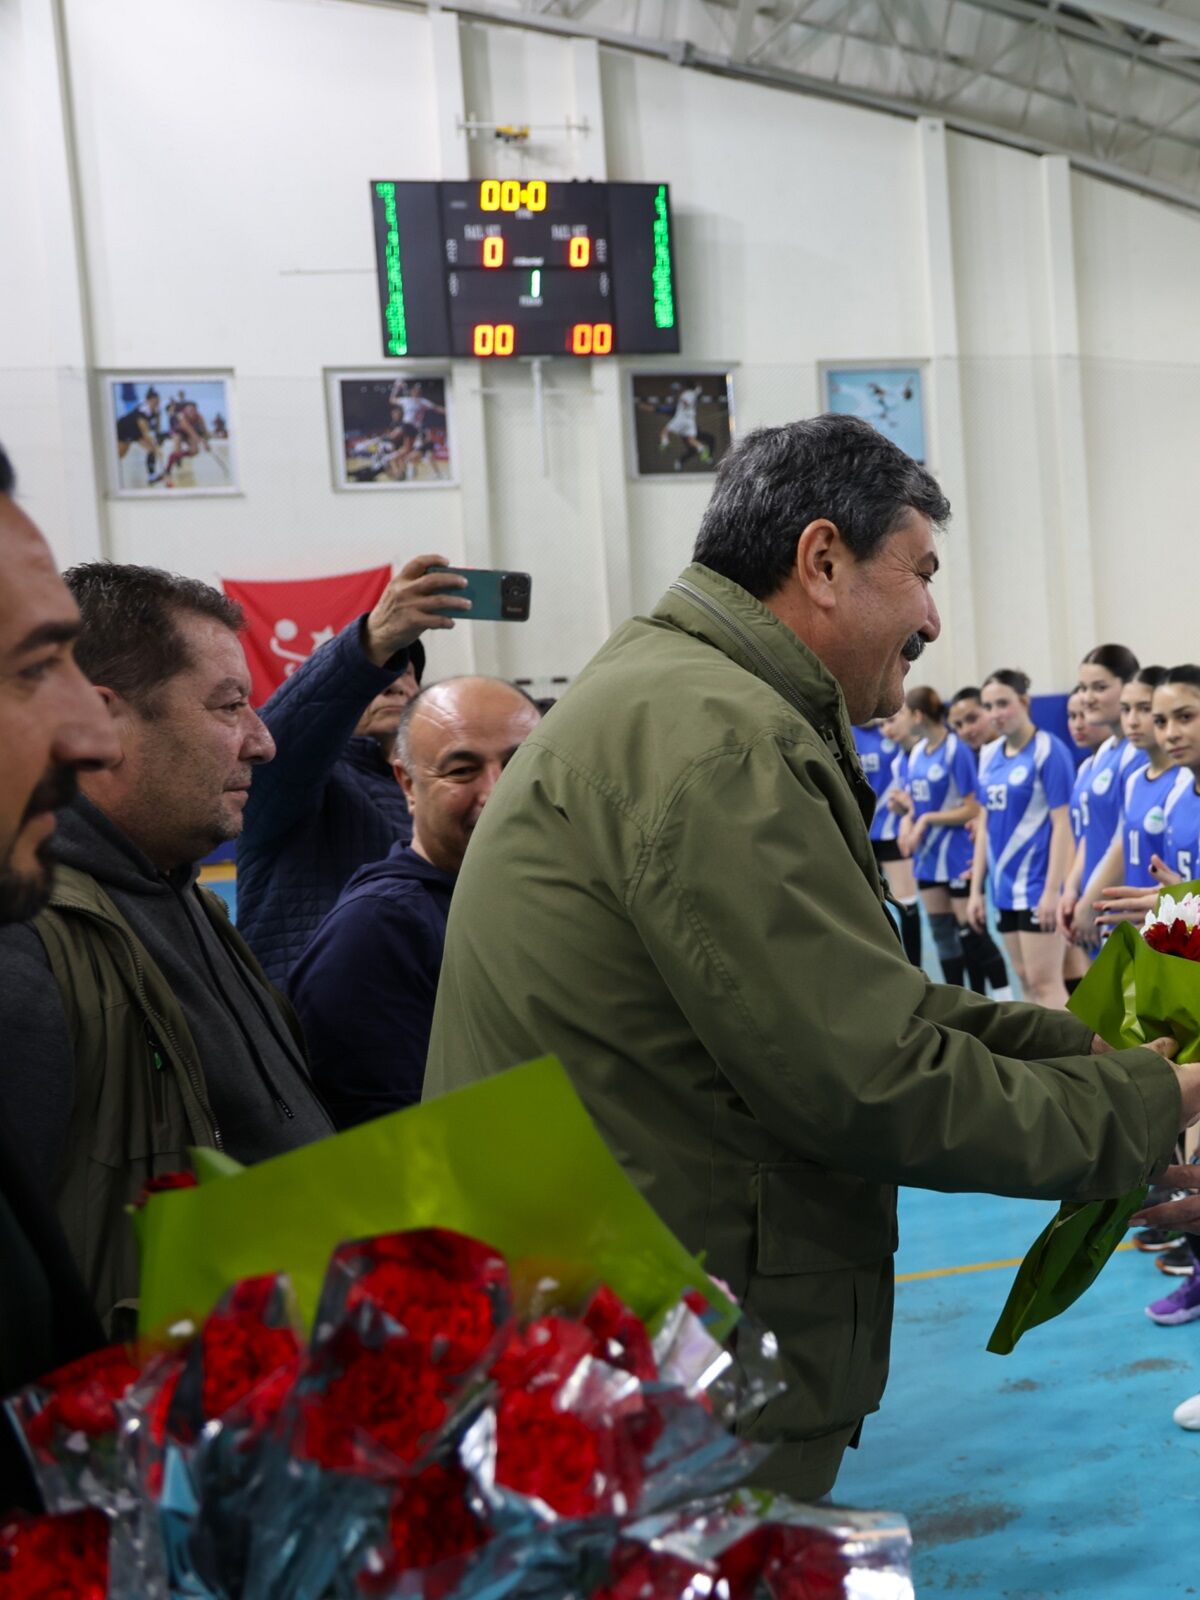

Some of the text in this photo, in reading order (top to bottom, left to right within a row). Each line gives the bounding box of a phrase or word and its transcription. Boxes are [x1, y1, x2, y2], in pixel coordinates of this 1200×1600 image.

[483, 236, 504, 268] 0
[569, 236, 590, 268] 0
[531, 269, 541, 298] 1
[474, 324, 514, 356] 00
[573, 323, 612, 354] 00
[986, 784, 1007, 811] 33
